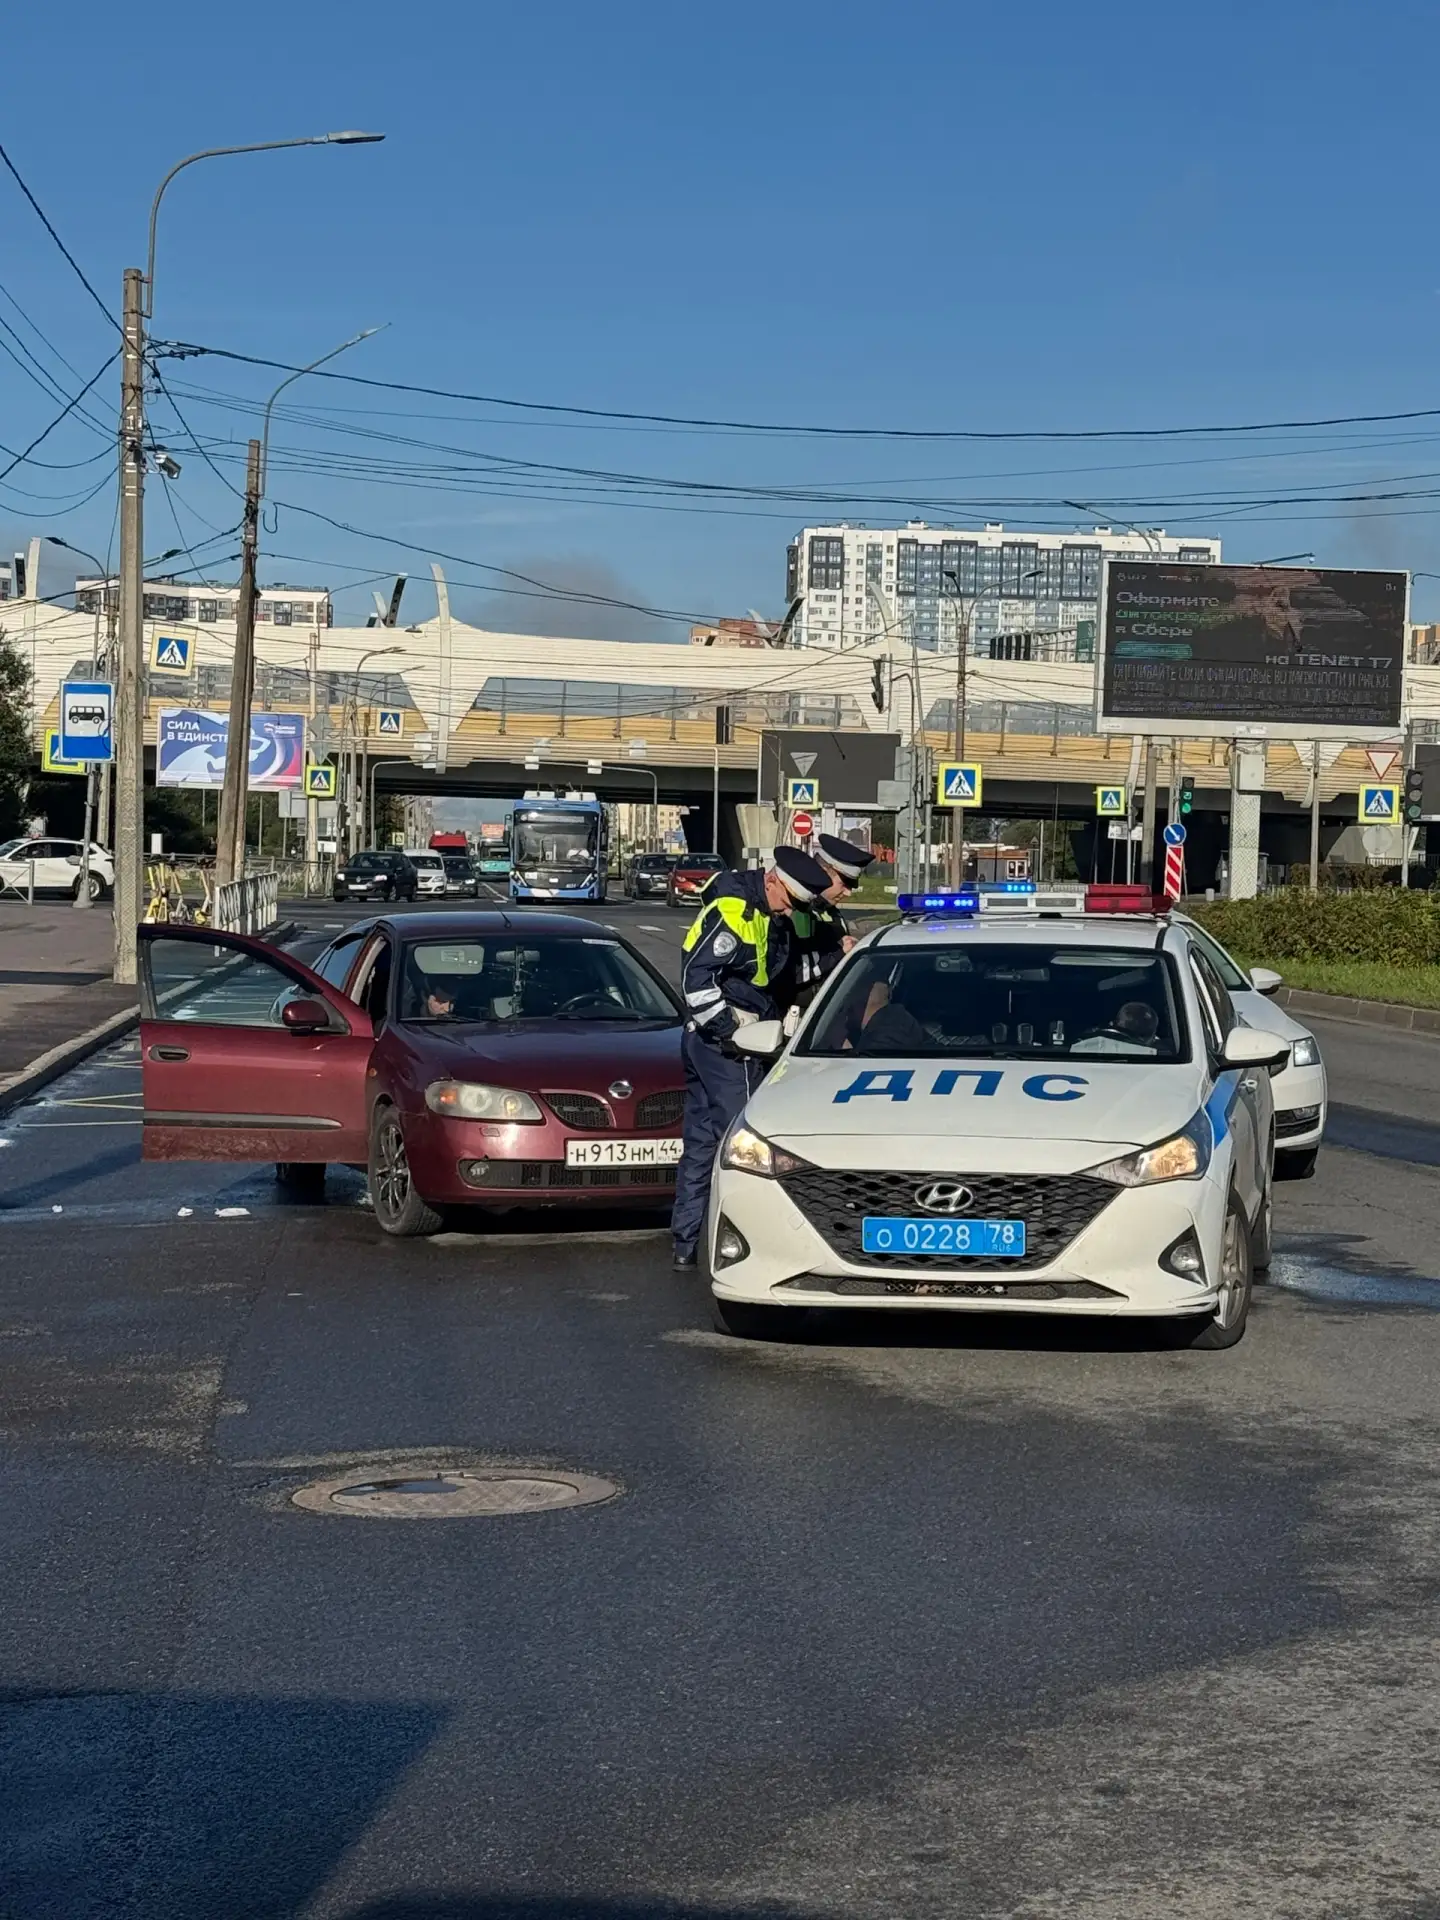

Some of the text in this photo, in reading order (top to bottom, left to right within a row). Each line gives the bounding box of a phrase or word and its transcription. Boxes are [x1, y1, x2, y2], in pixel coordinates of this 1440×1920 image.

[1265, 653, 1393, 669] на TENET T7
[167, 720, 200, 731] СИЛА
[167, 732, 175, 740] В
[832, 1069, 1090, 1103] ДПС
[660, 1140, 677, 1155] 44
[903, 1223, 971, 1250] 0228
[988, 1223, 1015, 1244] 78
